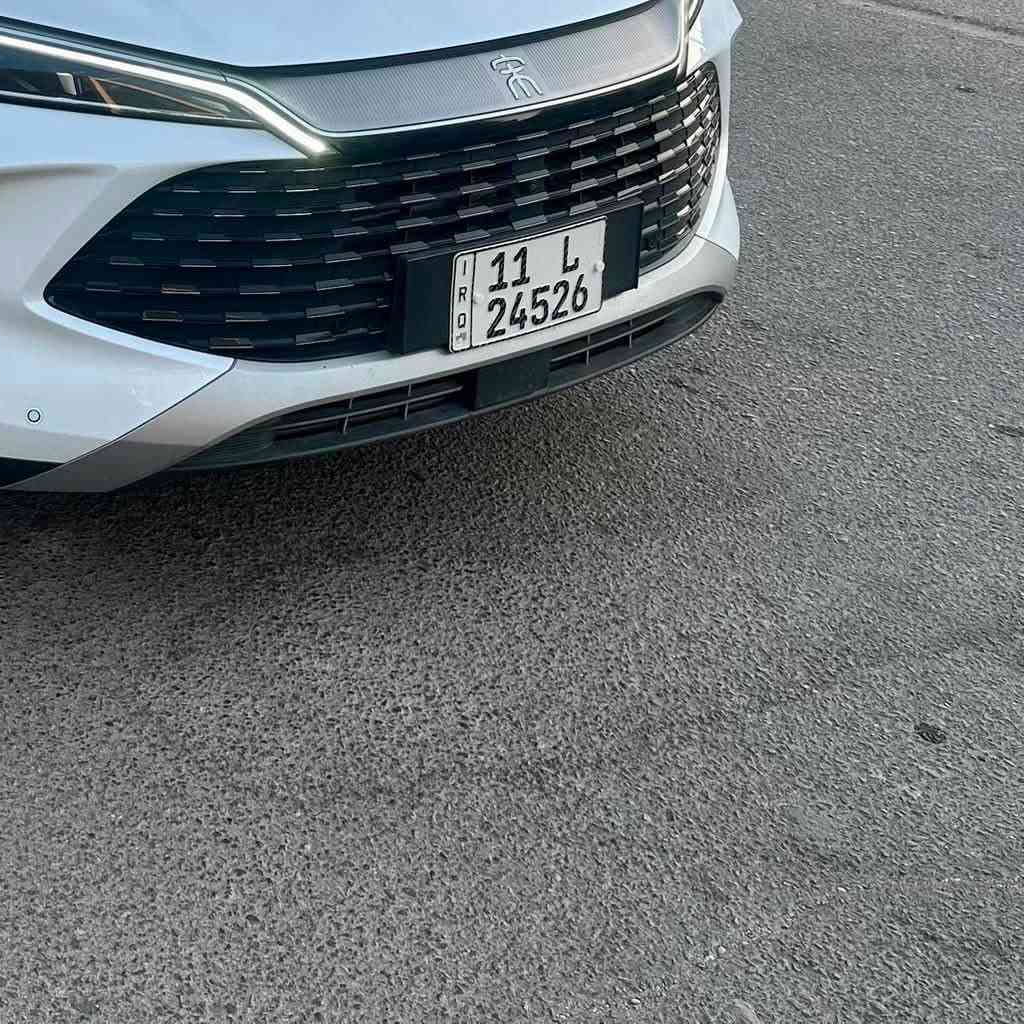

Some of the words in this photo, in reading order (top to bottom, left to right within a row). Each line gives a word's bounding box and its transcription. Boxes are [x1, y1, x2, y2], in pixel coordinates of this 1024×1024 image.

[489, 246, 530, 292] 11
[561, 235, 580, 274] L
[486, 273, 589, 339] 24526
